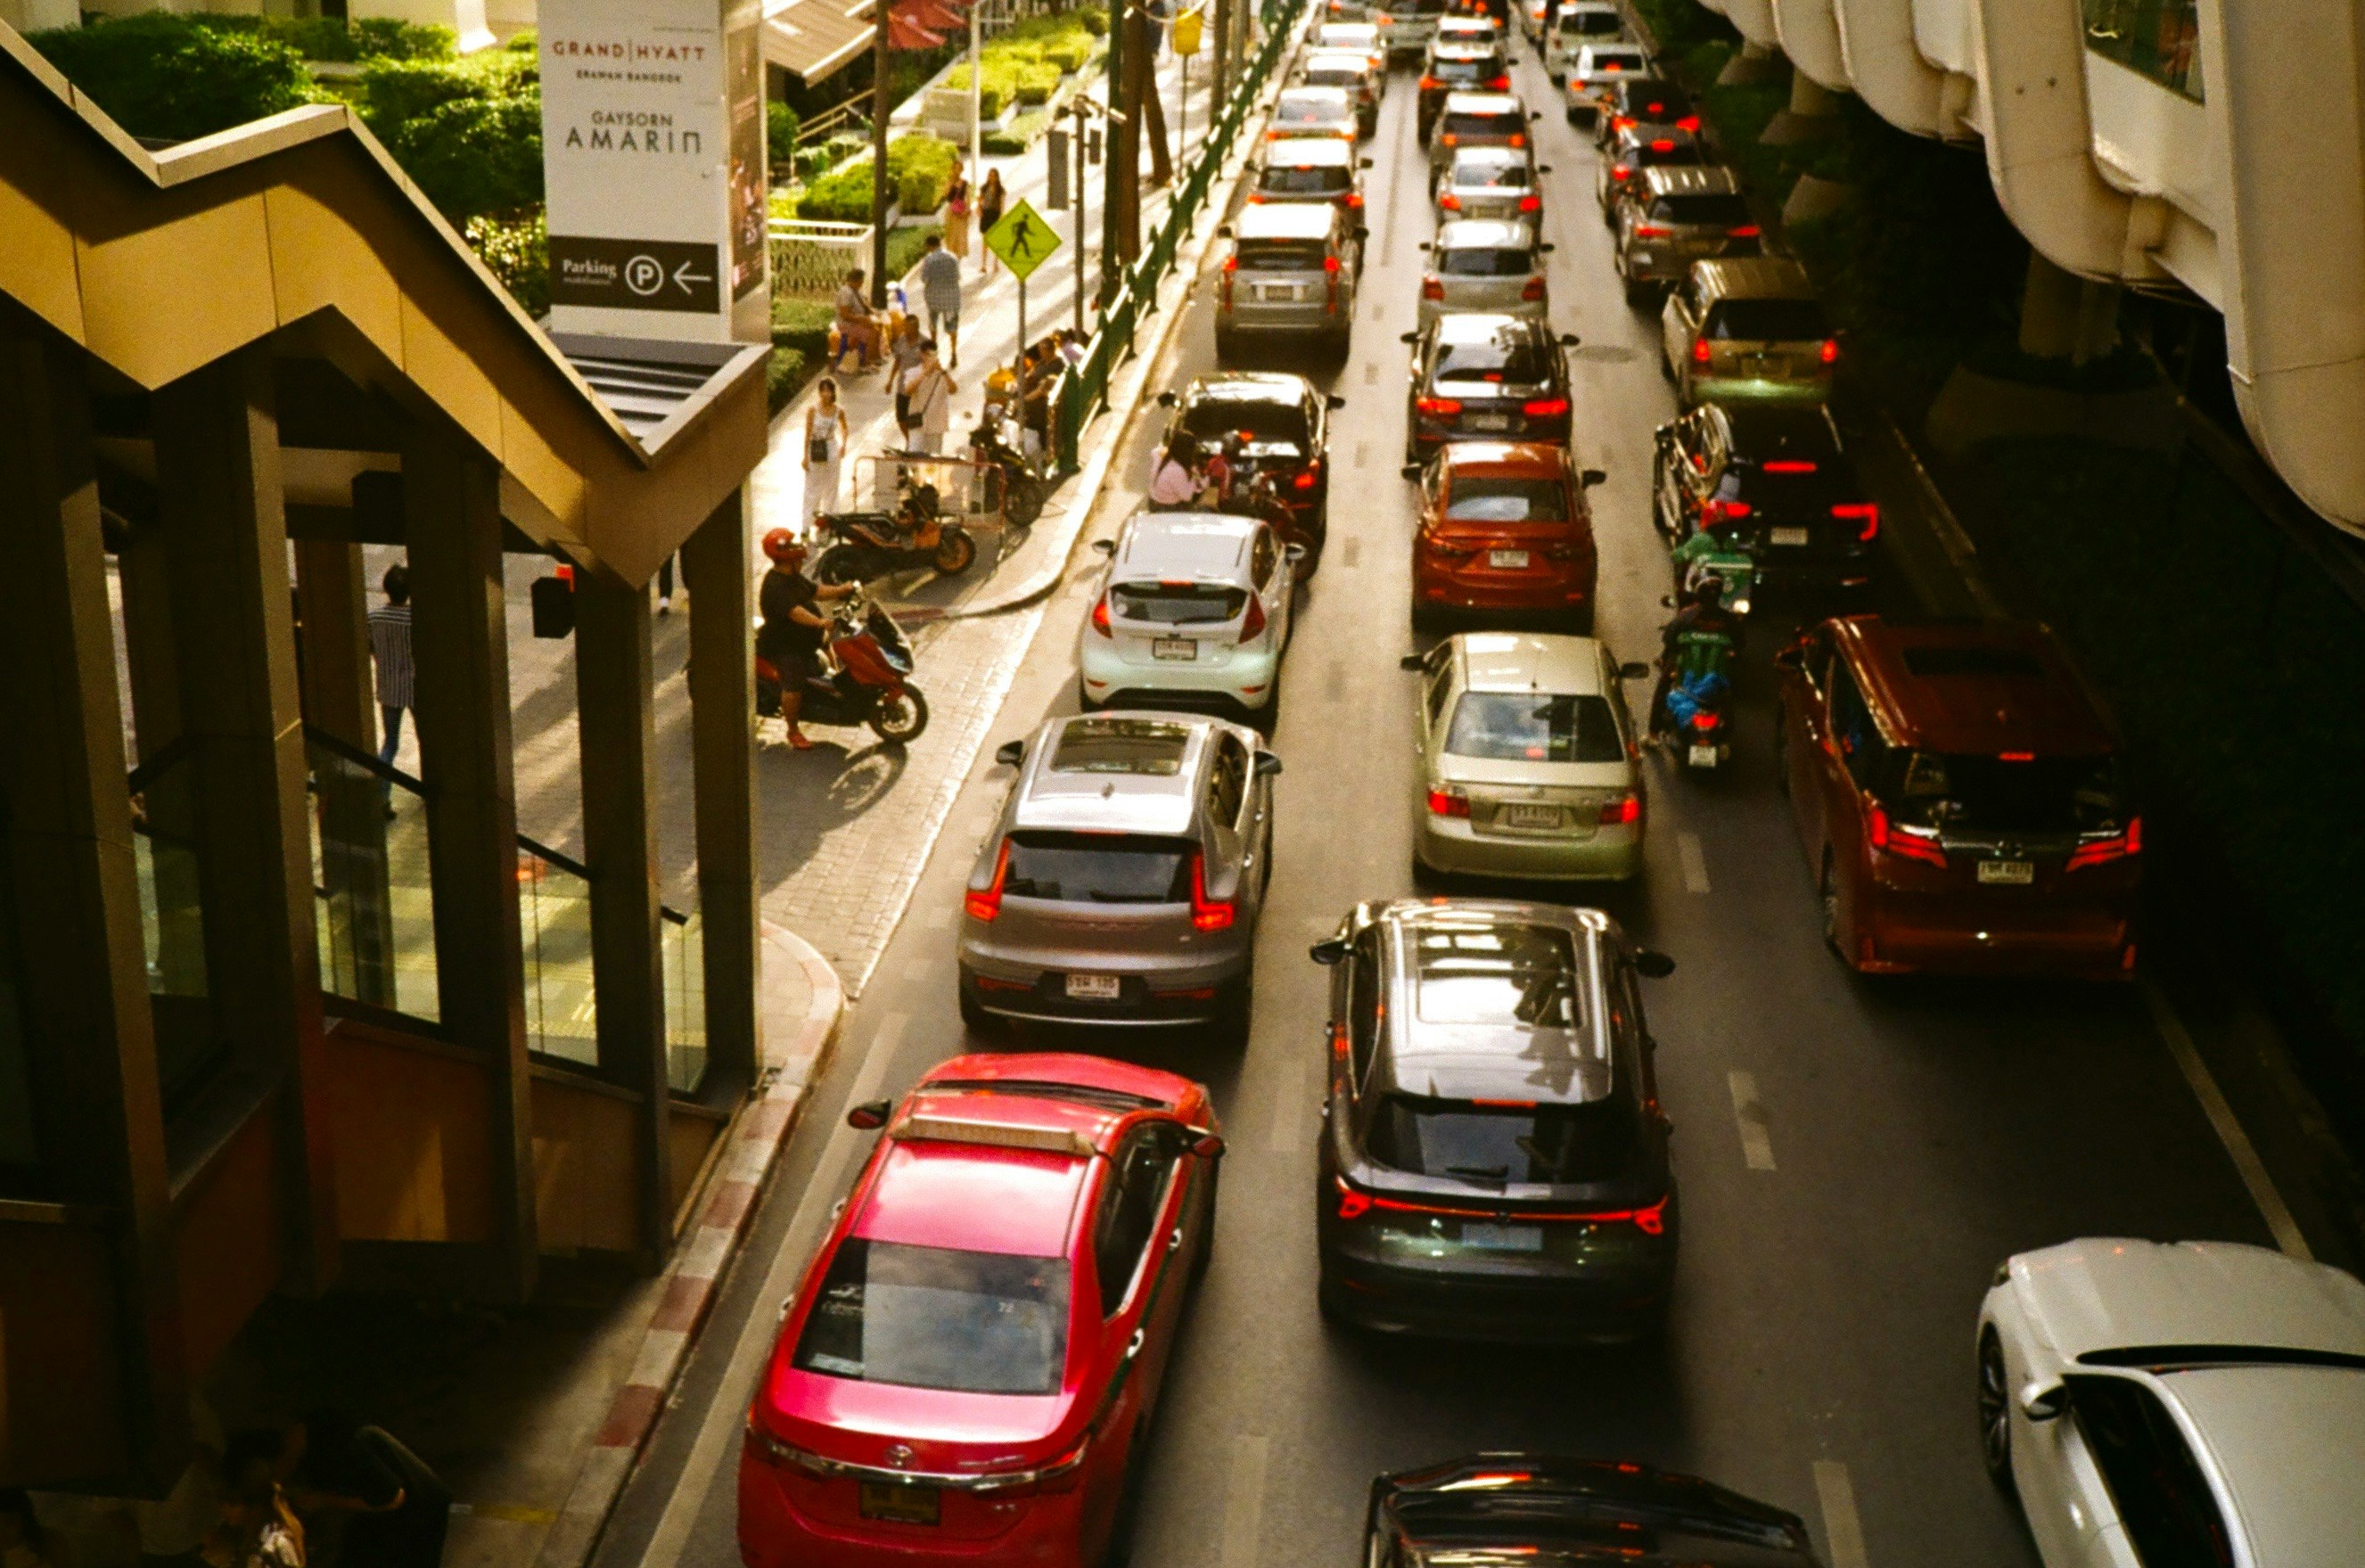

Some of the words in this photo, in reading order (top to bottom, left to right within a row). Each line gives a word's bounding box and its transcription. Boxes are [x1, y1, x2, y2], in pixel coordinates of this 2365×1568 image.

[552, 41, 625, 58] GRAND
[636, 45, 705, 61] HYATT
[591, 111, 673, 127] GAYSORN
[563, 259, 617, 279] Parking
